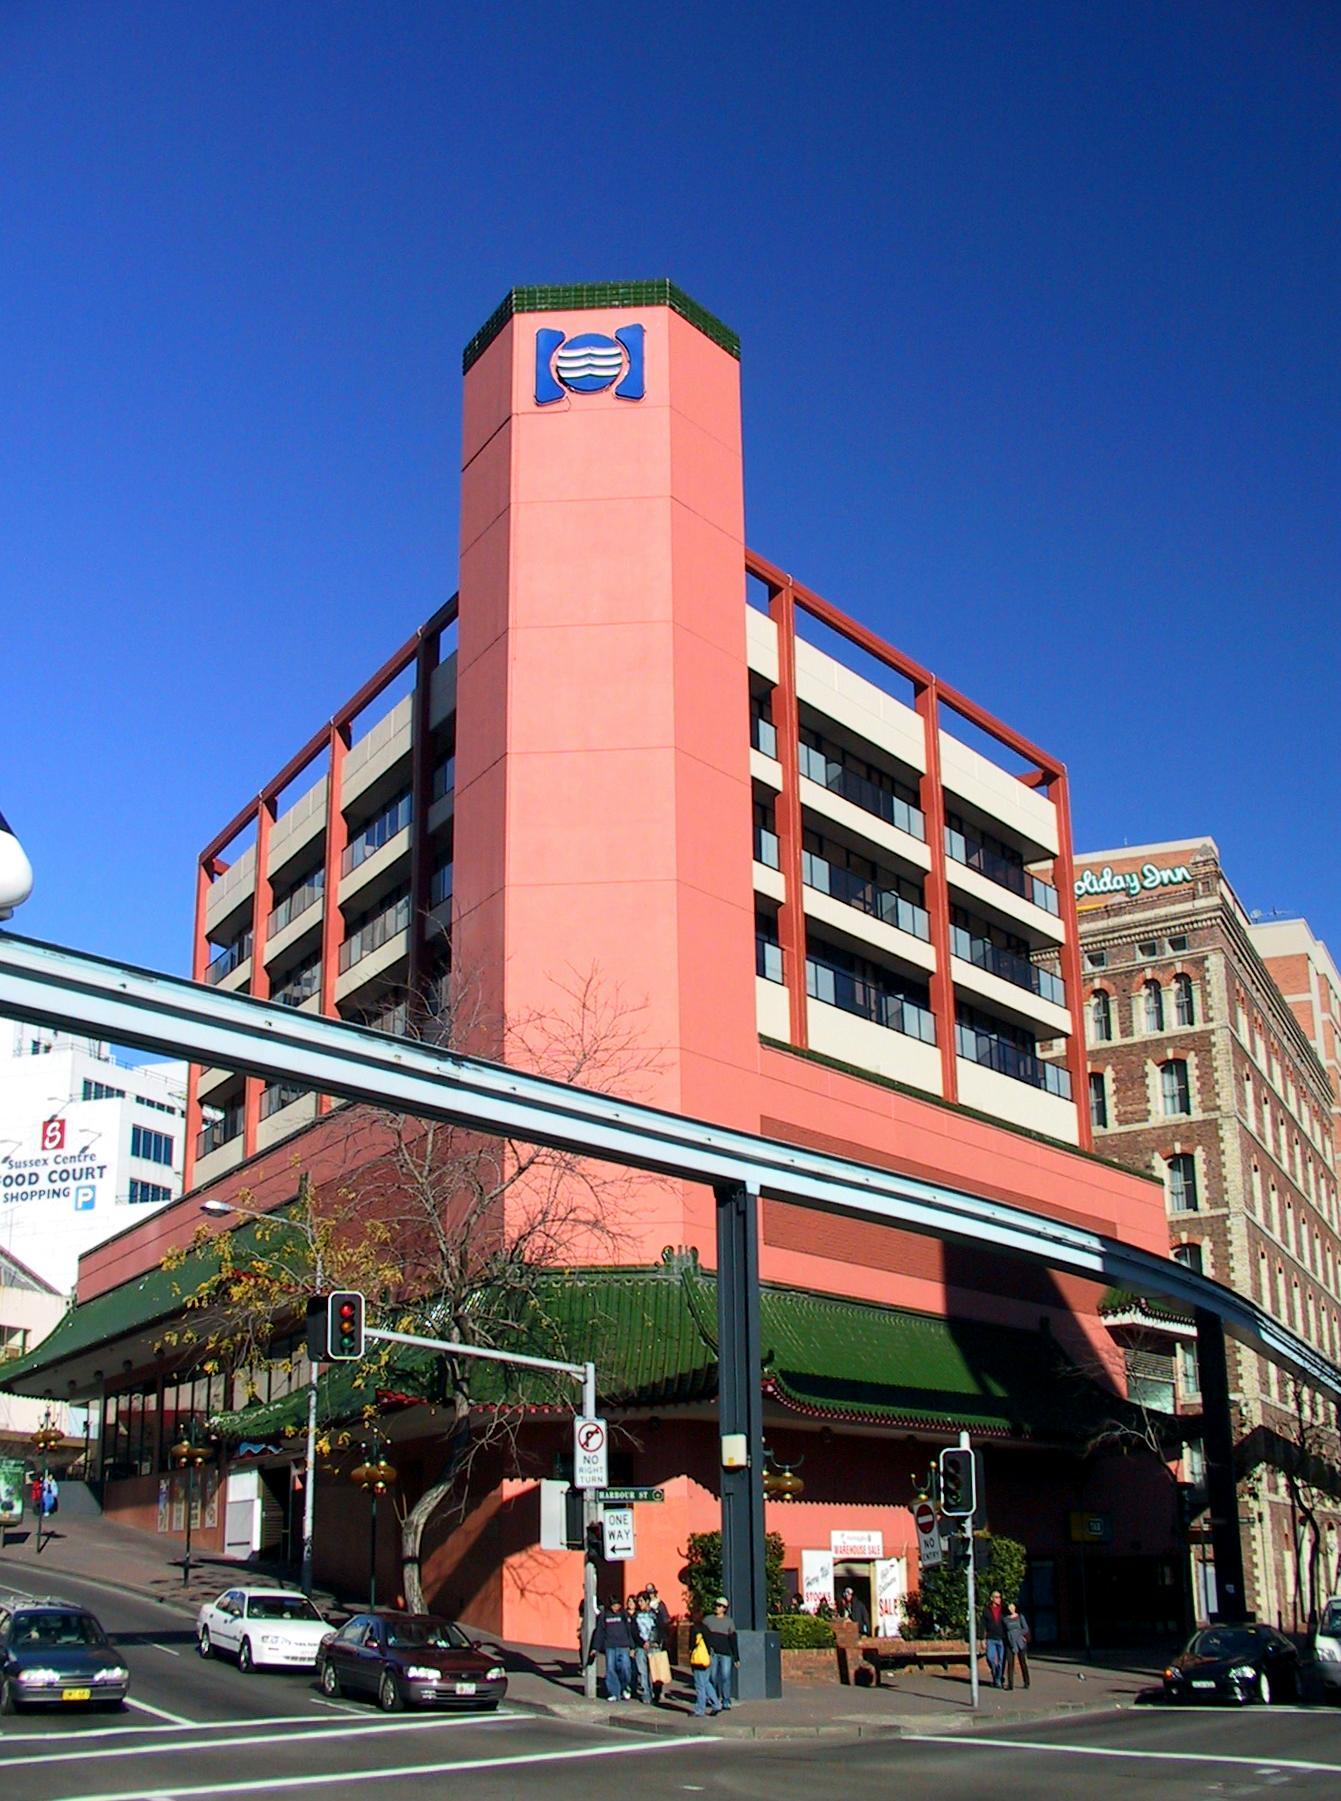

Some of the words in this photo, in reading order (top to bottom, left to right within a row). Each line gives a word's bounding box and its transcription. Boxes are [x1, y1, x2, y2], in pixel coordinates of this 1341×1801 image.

[1074, 866, 1141, 897] oliday
[1142, 864, 1193, 889] Inn
[8, 1158, 49, 1170] Sussex
[53, 1153, 97, 1165] Centre
[0, 1171, 40, 1188] OOD
[47, 1165, 107, 1184] COURT
[3, 1187, 71, 1203] SHOPPING
[583, 1455, 599, 1465] NO
[578, 1466, 604, 1474] RIGHT
[580, 1475, 603, 1484] TURN
[599, 1491, 635, 1499] HARBOUR
[638, 1491, 649, 1499] ST
[608, 1514, 629, 1526] ONE
[608, 1529, 631, 1541] WAY
[833, 1544, 866, 1555] WAREHOUSE
[867, 1544, 881, 1555] SALE
[923, 1537, 935, 1550] NO
[878, 1598, 899, 1617] SALE
